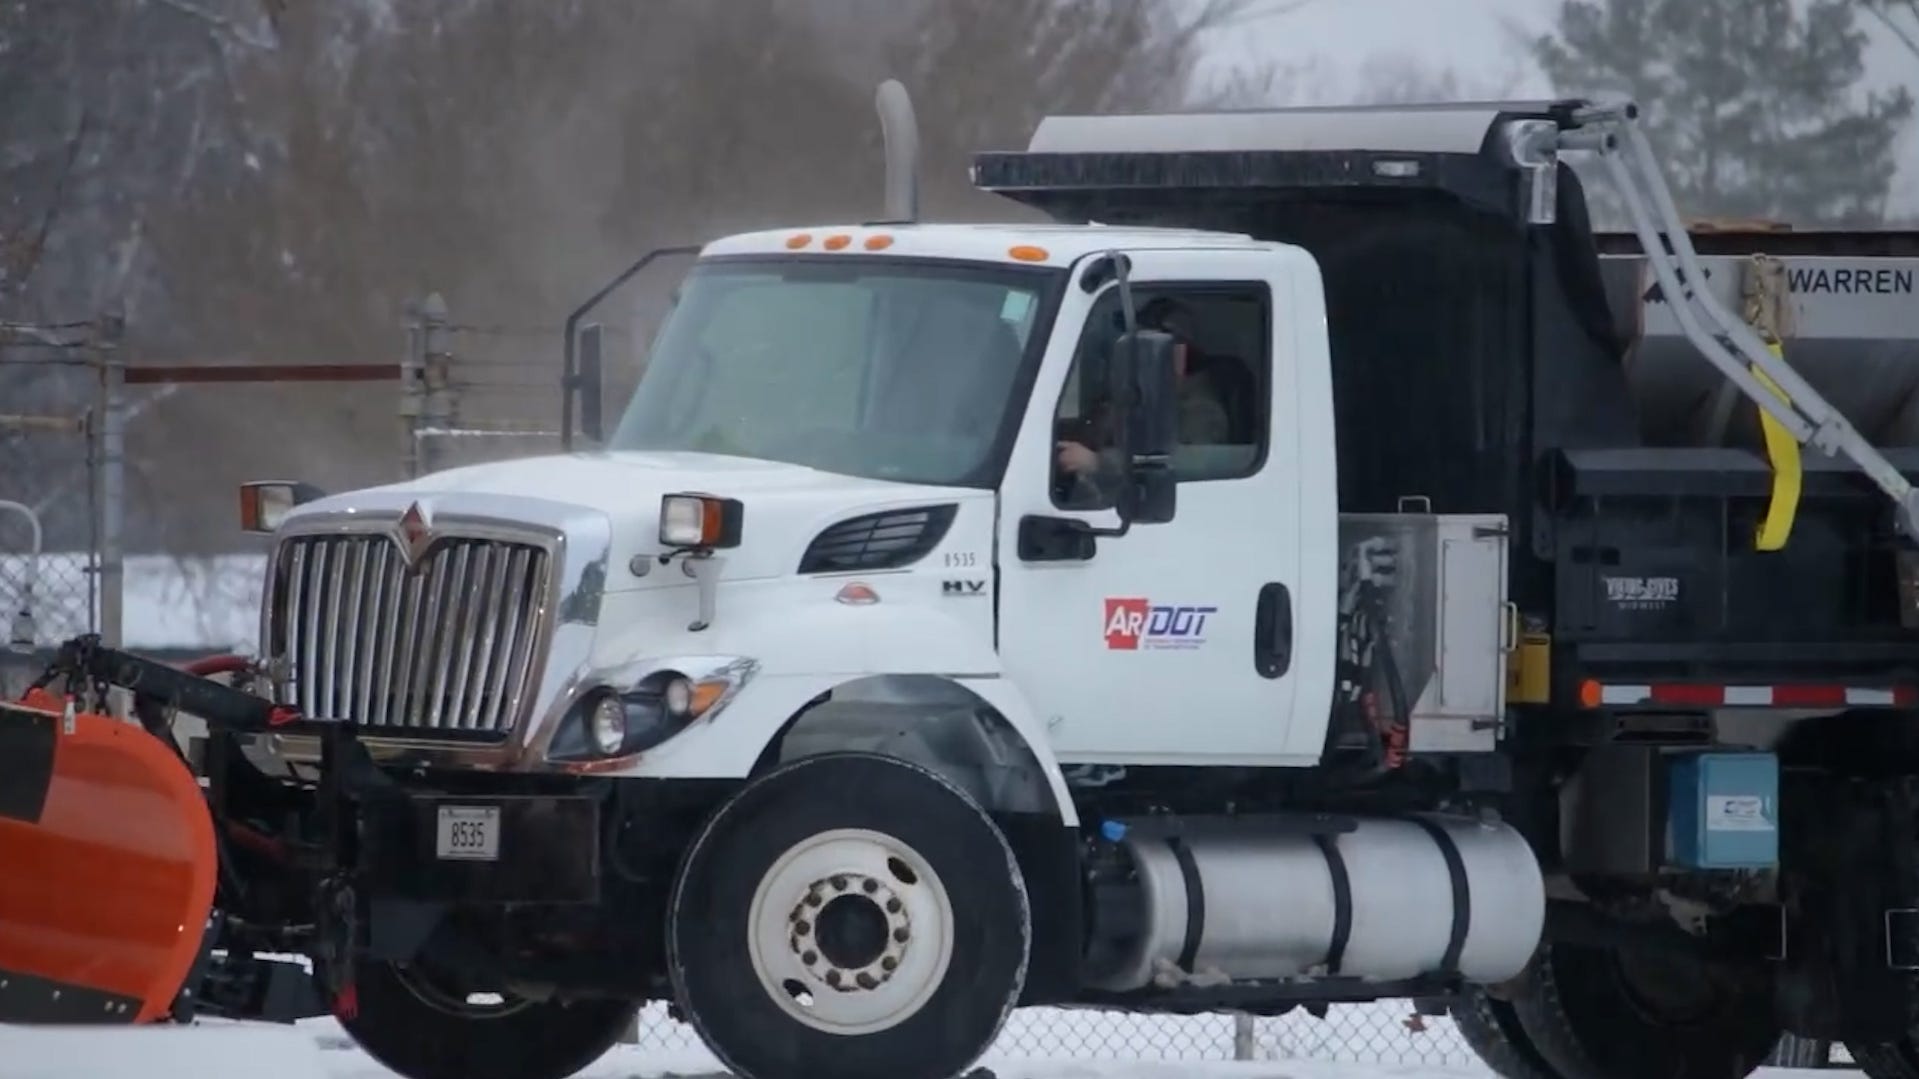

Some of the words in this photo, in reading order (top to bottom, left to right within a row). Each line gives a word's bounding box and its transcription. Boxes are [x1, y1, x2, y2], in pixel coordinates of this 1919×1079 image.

[1788, 269, 1912, 294] WARREN
[942, 580, 985, 592] HV
[451, 821, 485, 847] 8535
